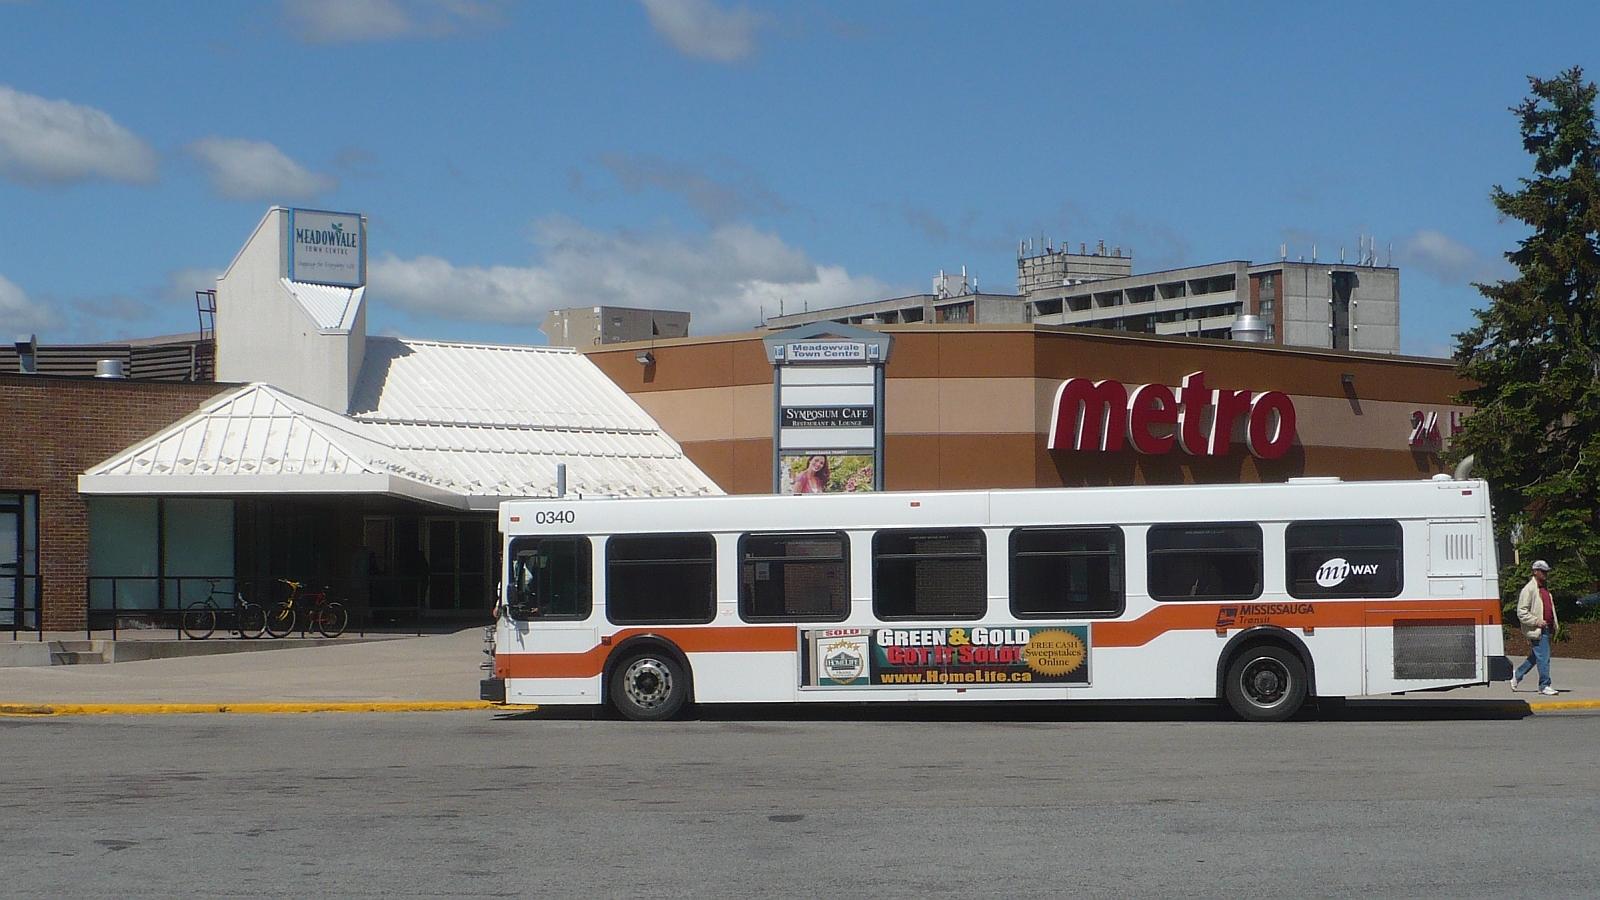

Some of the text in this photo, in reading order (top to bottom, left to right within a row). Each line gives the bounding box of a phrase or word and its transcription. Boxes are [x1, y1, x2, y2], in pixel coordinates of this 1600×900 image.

[296, 228, 357, 248] MEADOWVALE
[786, 408, 868, 420] SYMPOSIUM CAFE
[1047, 371, 1297, 459] metro
[1408, 410, 1442, 447] 24
[535, 510, 576, 524] 0340
[1240, 604, 1314, 615] MISSISSAUGA
[1240, 615, 1270, 624] Transit
[825, 628, 860, 636] SOLD
[876, 628, 1030, 646] GREEN & GOLD
[1031, 641, 1078, 649] FREE CASH
[1025, 649, 1081, 660] Sweepstakes
[1038, 658, 1070, 666] Online
[880, 670, 1032, 684] www.HomeLife.ca
